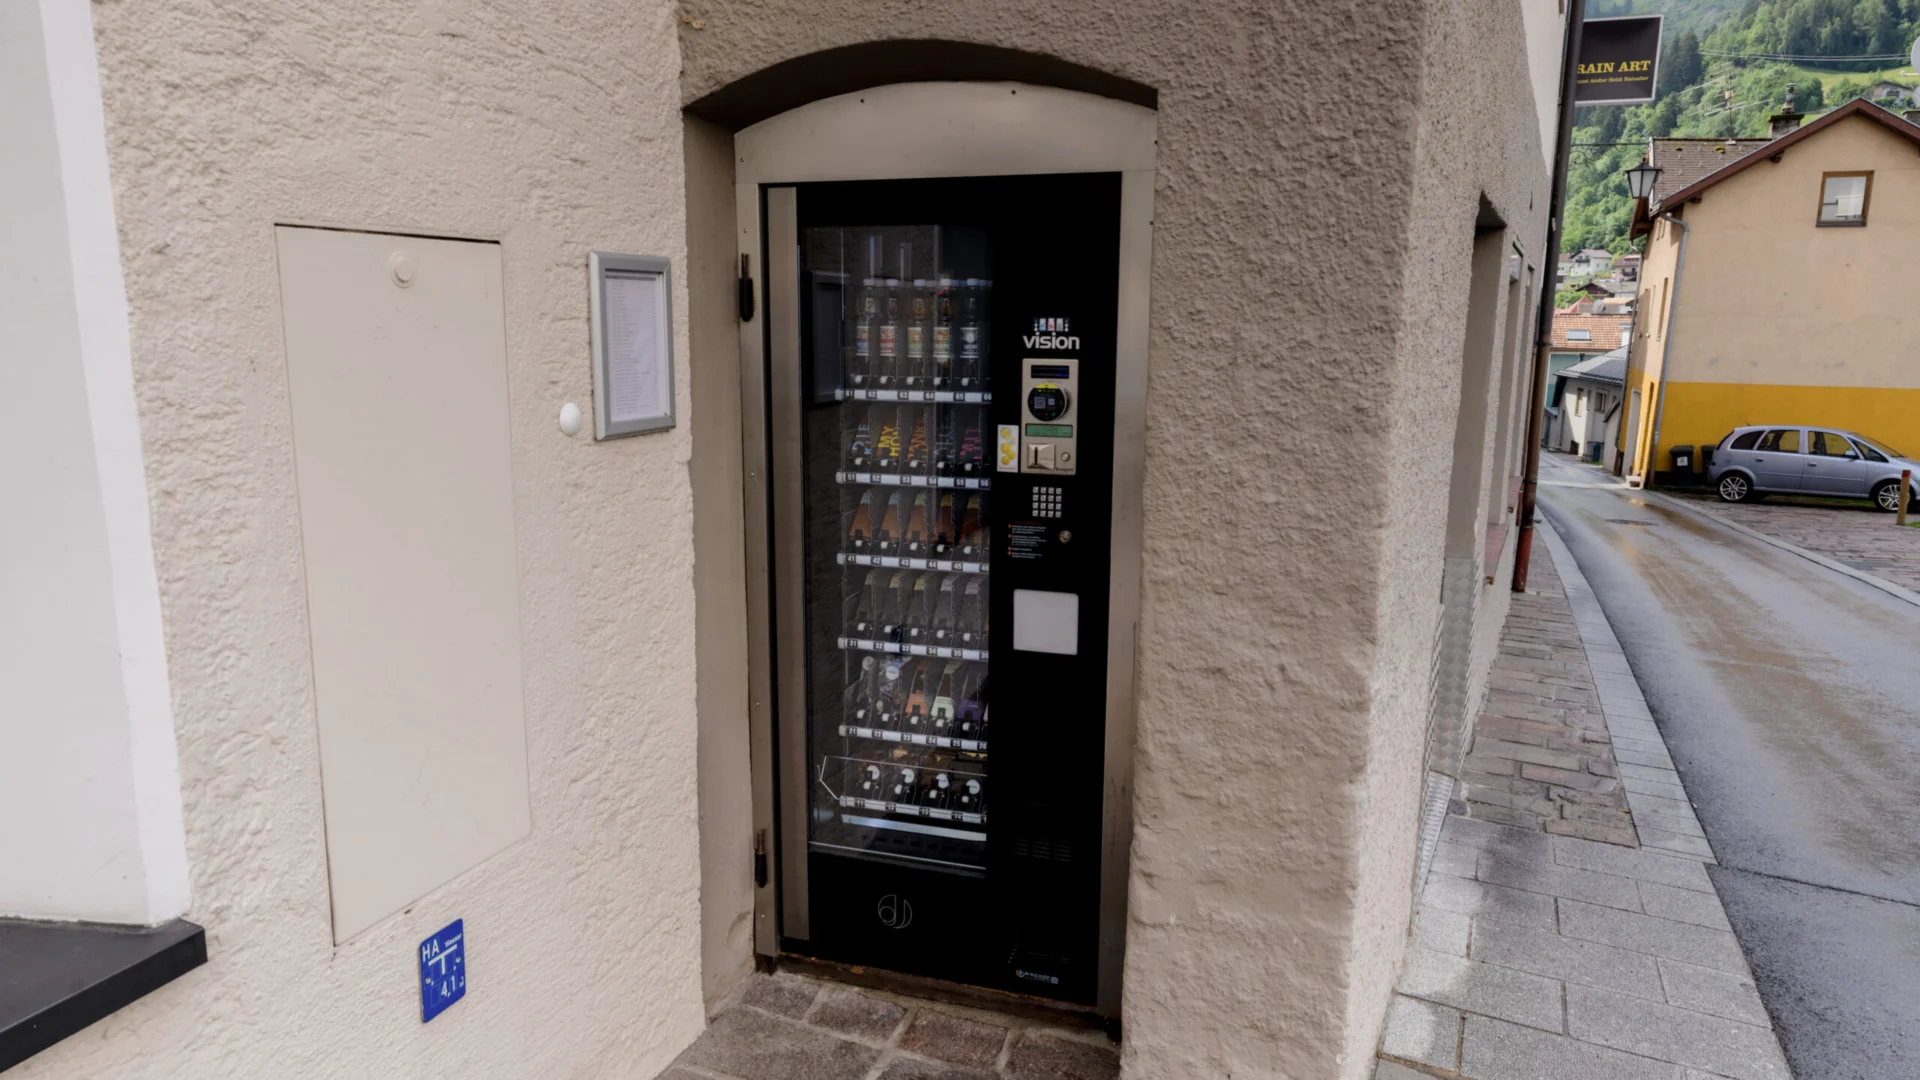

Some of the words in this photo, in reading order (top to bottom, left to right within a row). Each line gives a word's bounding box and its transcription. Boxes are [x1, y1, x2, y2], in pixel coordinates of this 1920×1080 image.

[1618, 60, 1651, 72] ART
[1022, 331, 1080, 350] vision
[902, 476, 910, 484] 53
[953, 562, 962, 570] 45
[875, 642, 882, 650] 32
[928, 646, 936, 654] 34
[422, 939, 440, 963] HA
